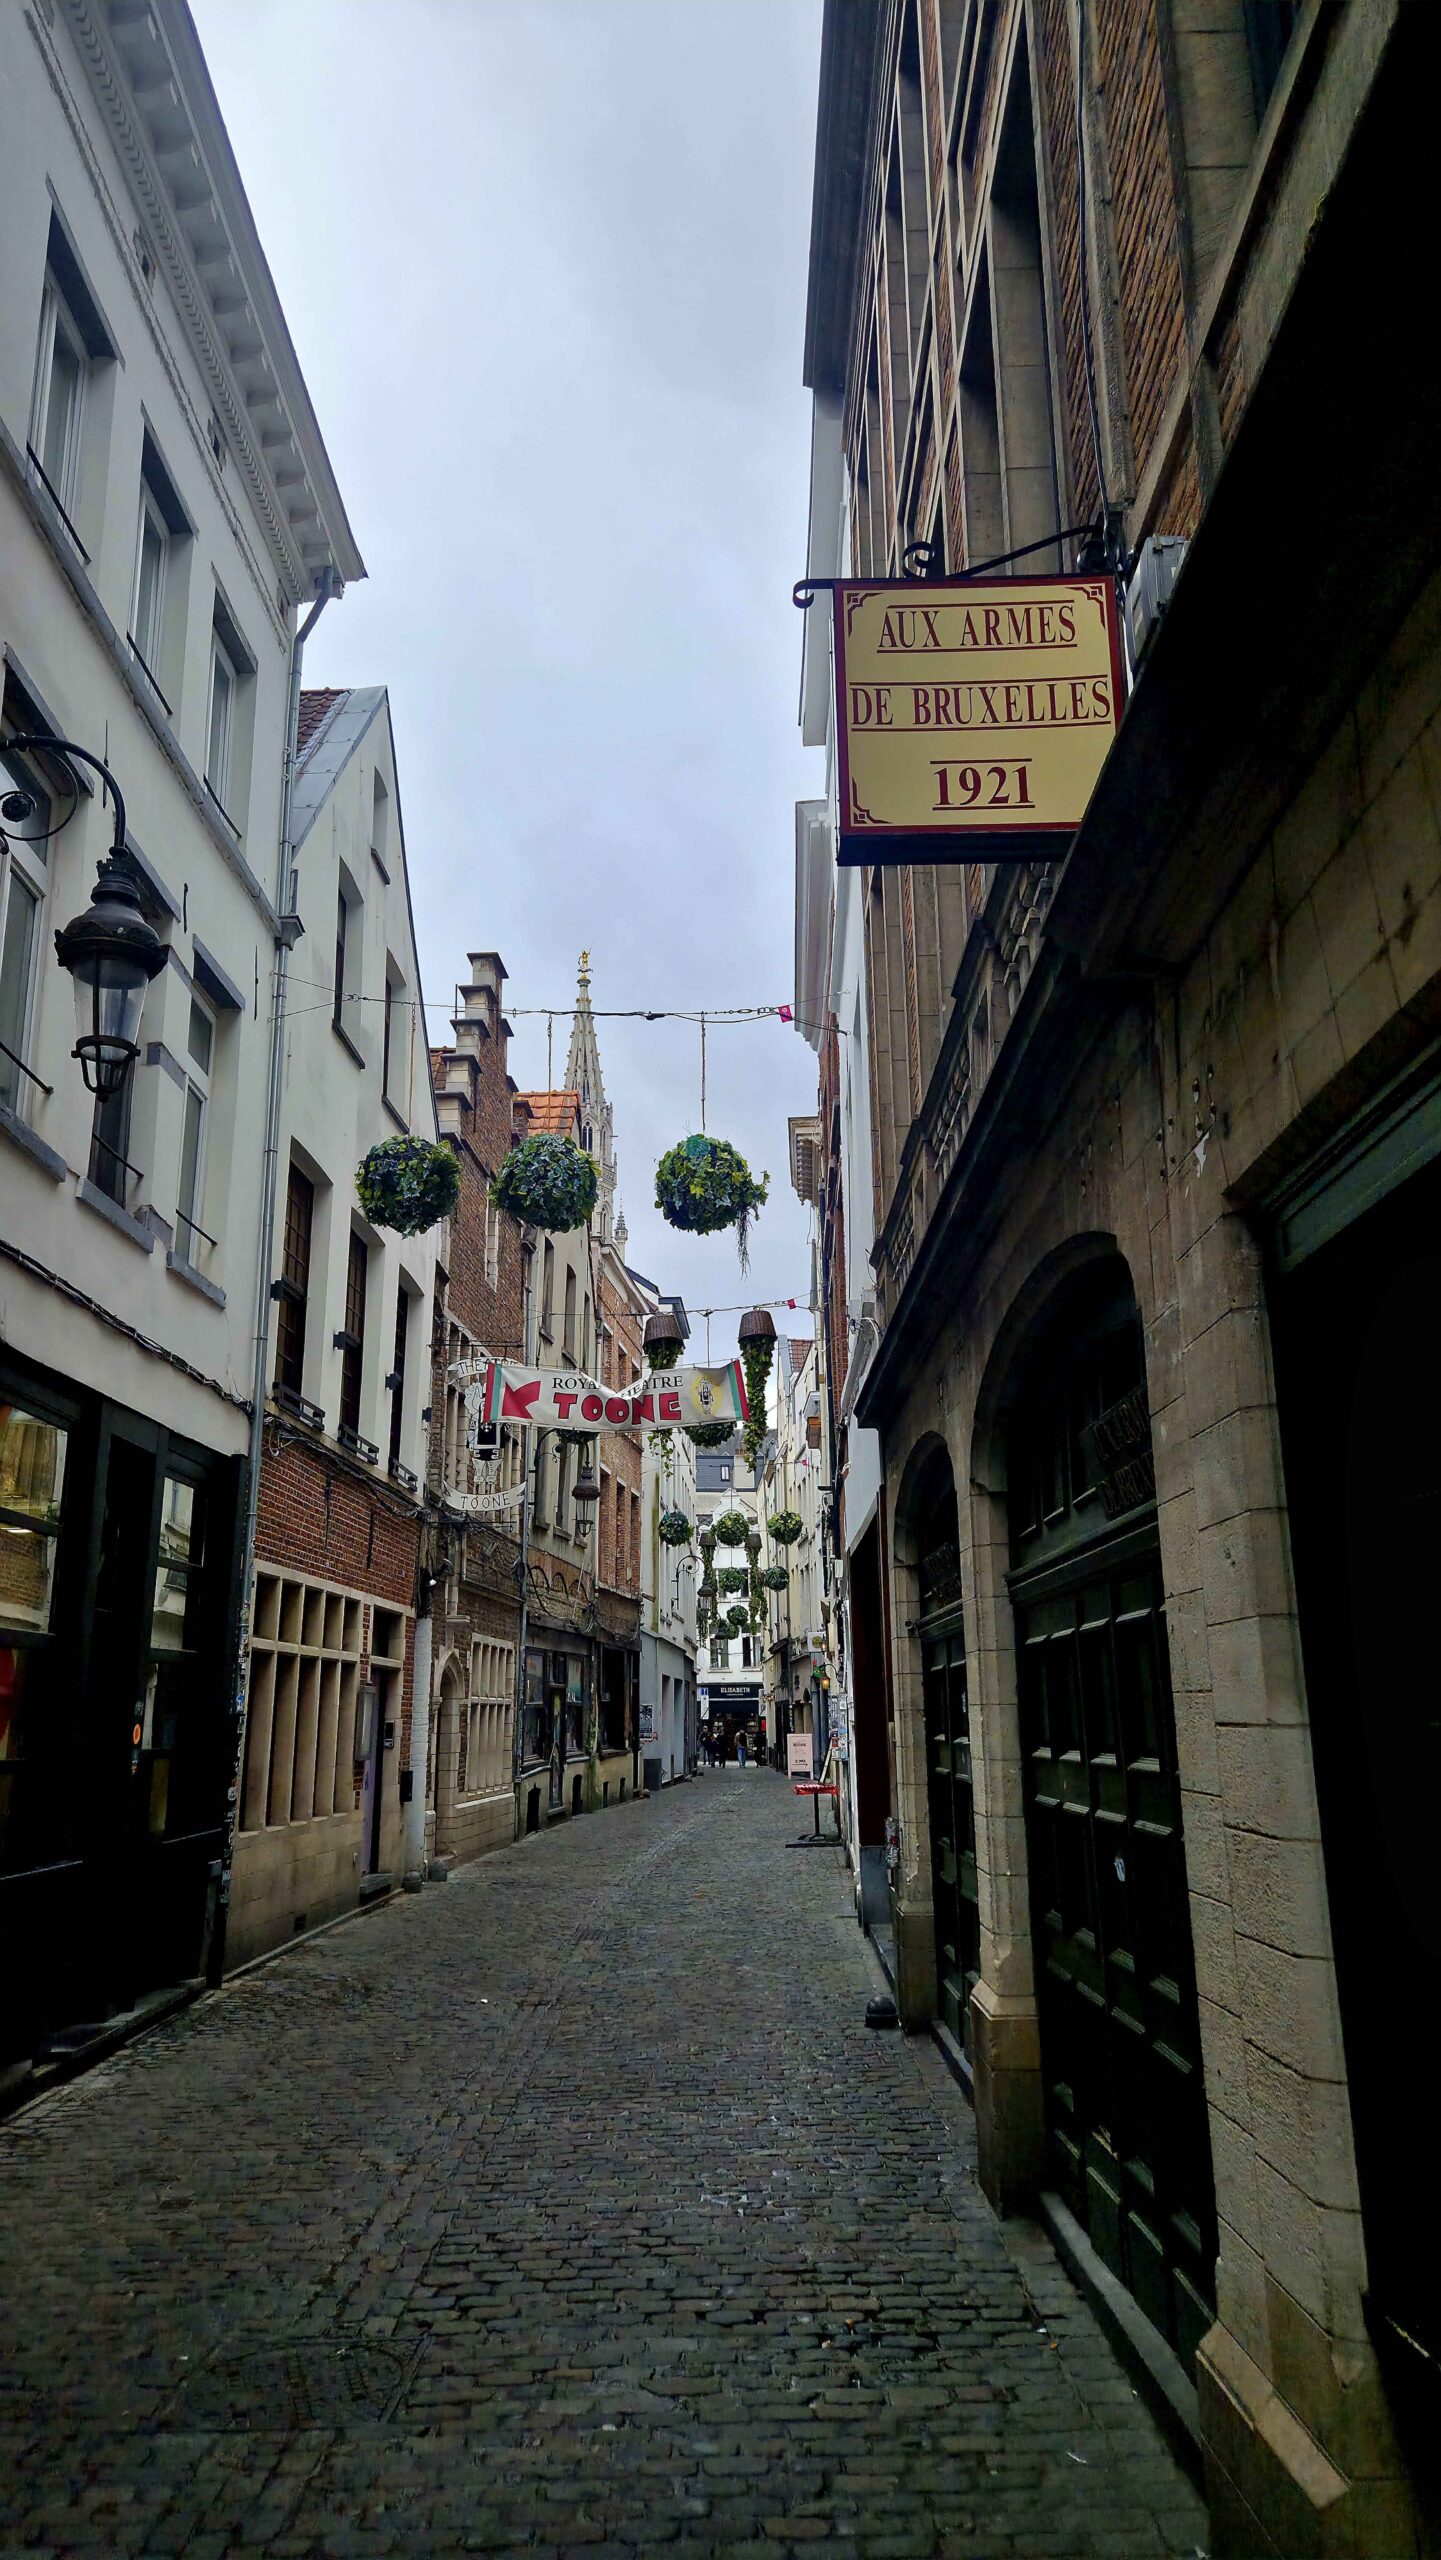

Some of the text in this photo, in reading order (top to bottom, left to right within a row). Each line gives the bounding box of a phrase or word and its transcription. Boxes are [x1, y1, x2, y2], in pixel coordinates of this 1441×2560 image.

[878, 605, 1076, 648] AUX ARMES
[851, 680, 1111, 725] DE BRUXELLES
[933, 765, 1034, 806] 1921
[552, 1376, 683, 1397] ROYA HEATRE
[552, 1391, 682, 1425] TOONE
[460, 1492, 511, 1509] TOONE
